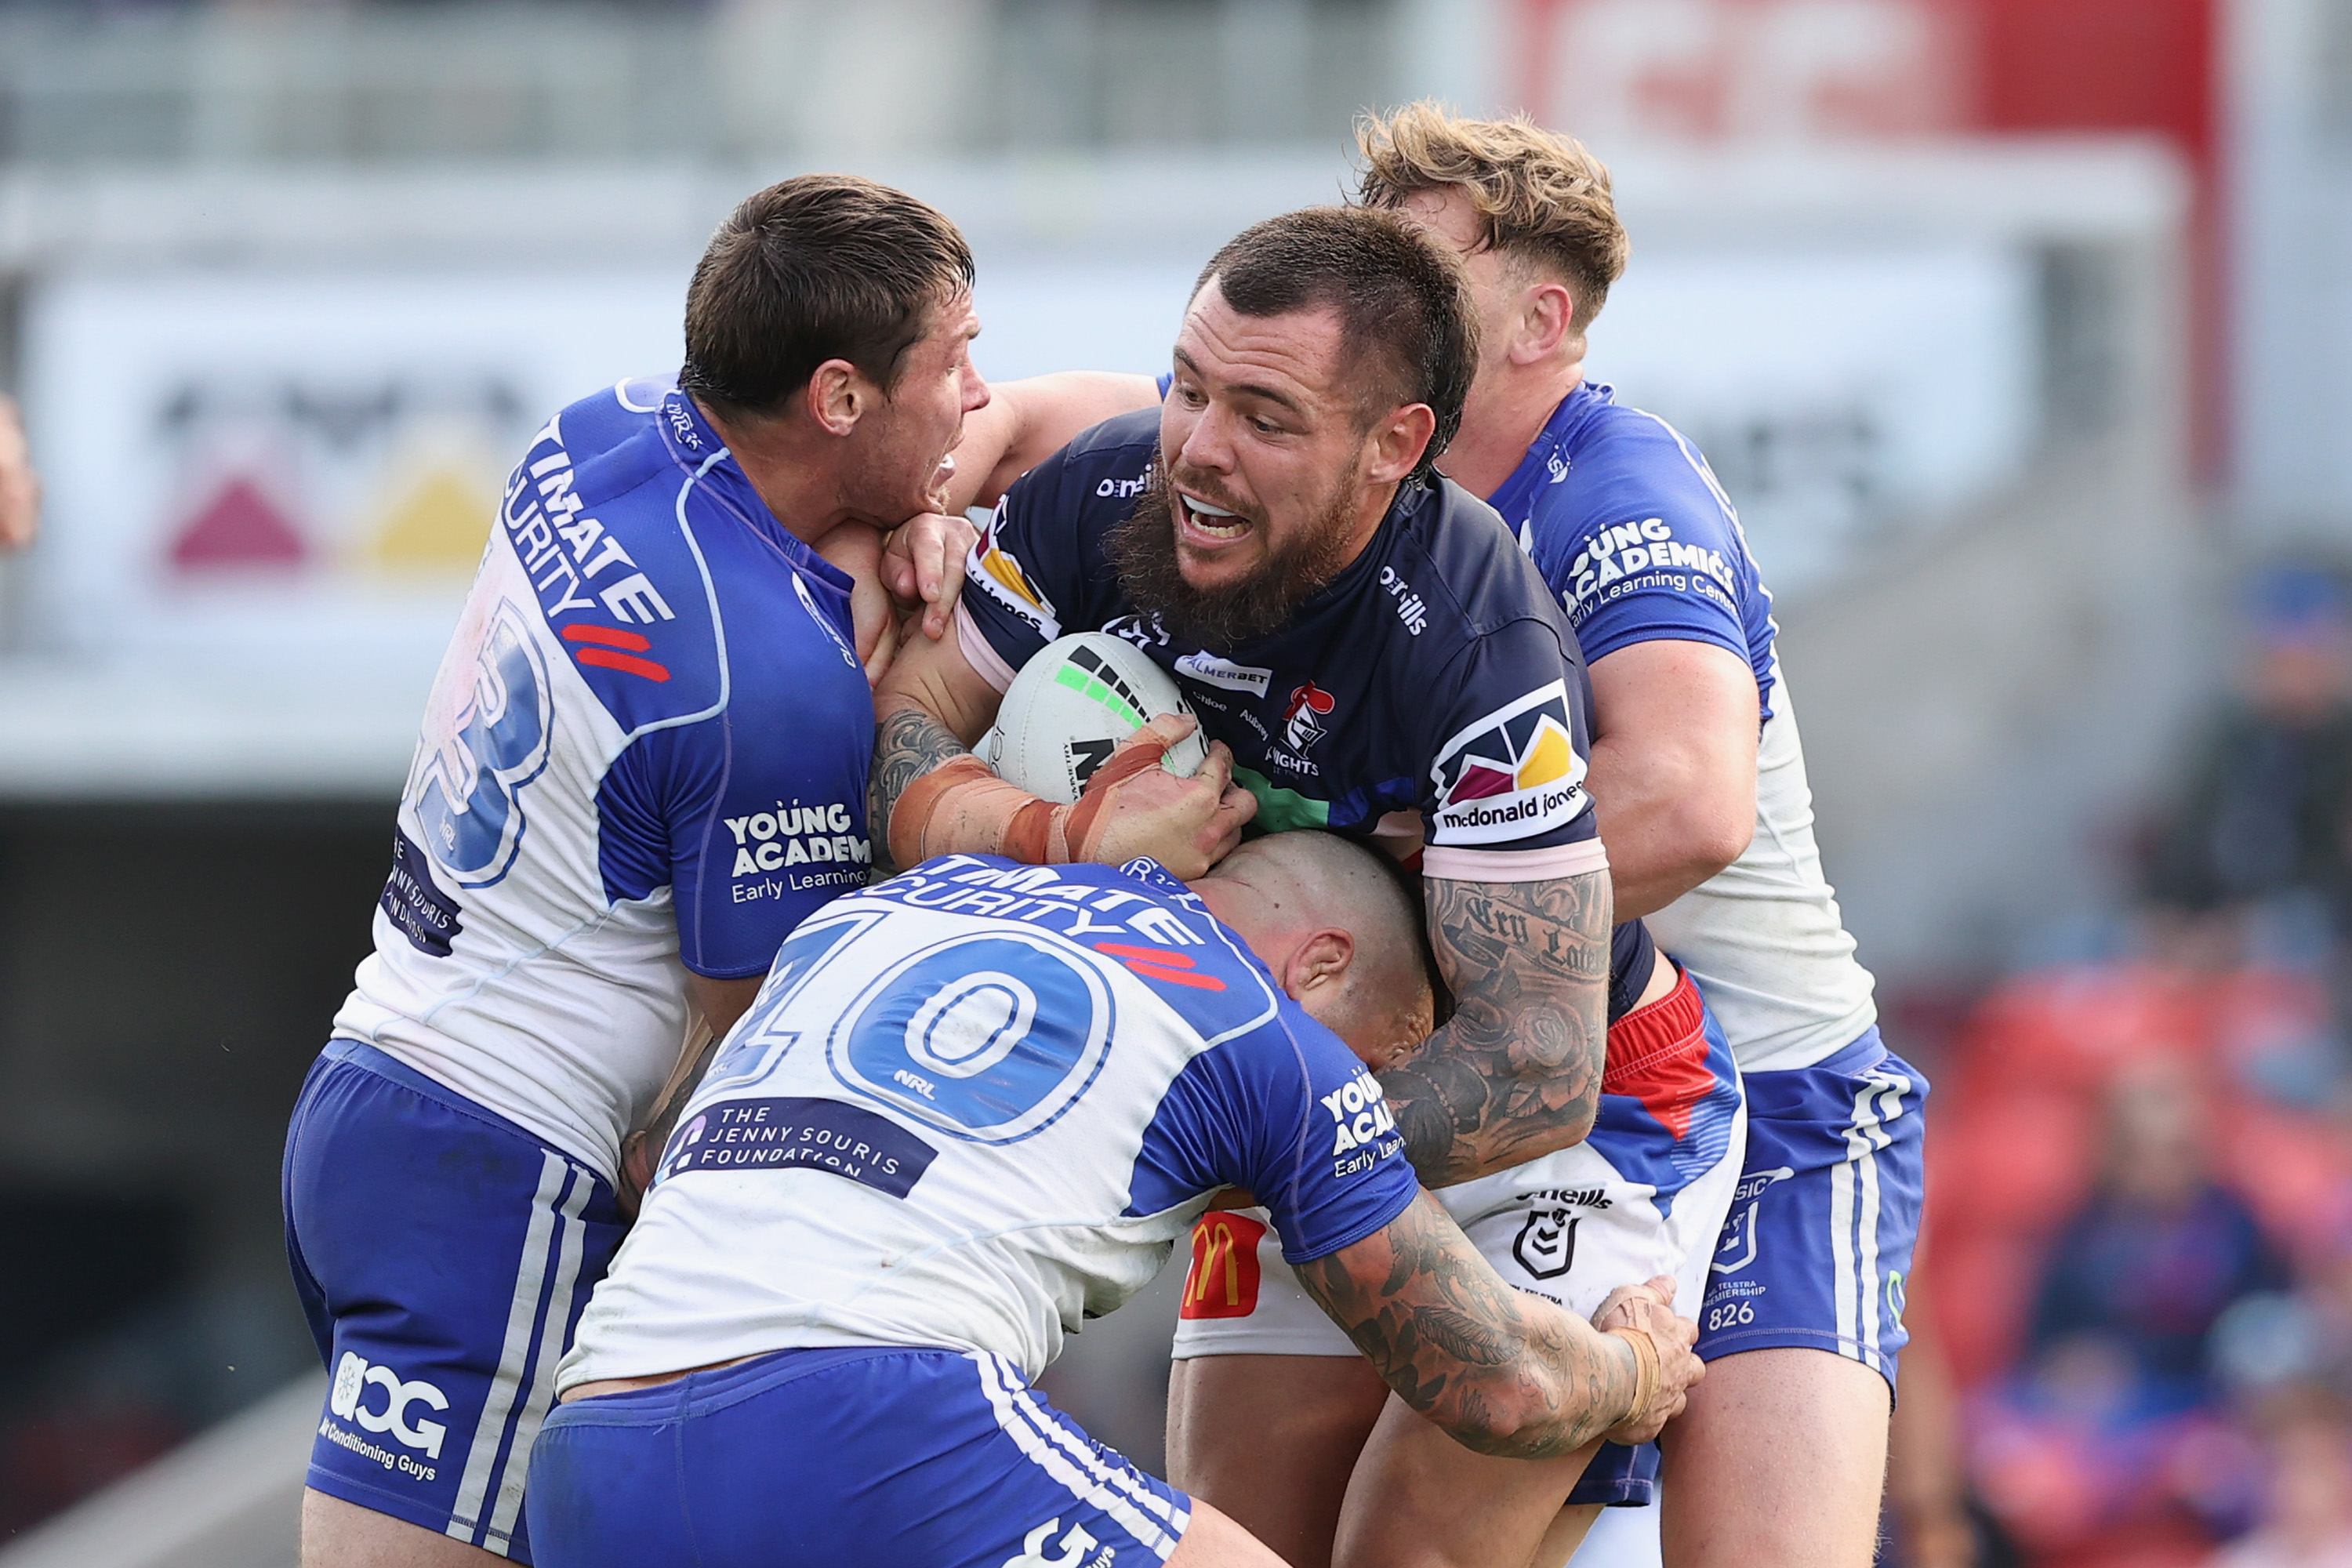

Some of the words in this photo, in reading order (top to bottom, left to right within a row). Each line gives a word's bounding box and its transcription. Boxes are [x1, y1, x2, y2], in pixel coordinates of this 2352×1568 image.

[1571, 598, 1594, 627] arly
[1598, 571, 1686, 604] Learning
[1240, 709, 1269, 742] Aubrey
[1062, 742, 1079, 801] YMMETRY
[732, 882, 783, 903] Early
[893, 1069, 936, 1101] NRL
[721, 1106, 771, 1123] THE
[701, 1148, 863, 1178] FOUNDATION
[709, 1126, 793, 1144] JENNY
[798, 1127, 901, 1176] SOURIS
[1334, 1149, 1377, 1178] Early
[1734, 1178, 1768, 1202] SIC
[1718, 1279, 1757, 1291] TELSTRA
[1708, 1300, 1755, 1332] 826
[328, 1422, 396, 1471] Conditioning
[397, 1454, 437, 1482] Guys
